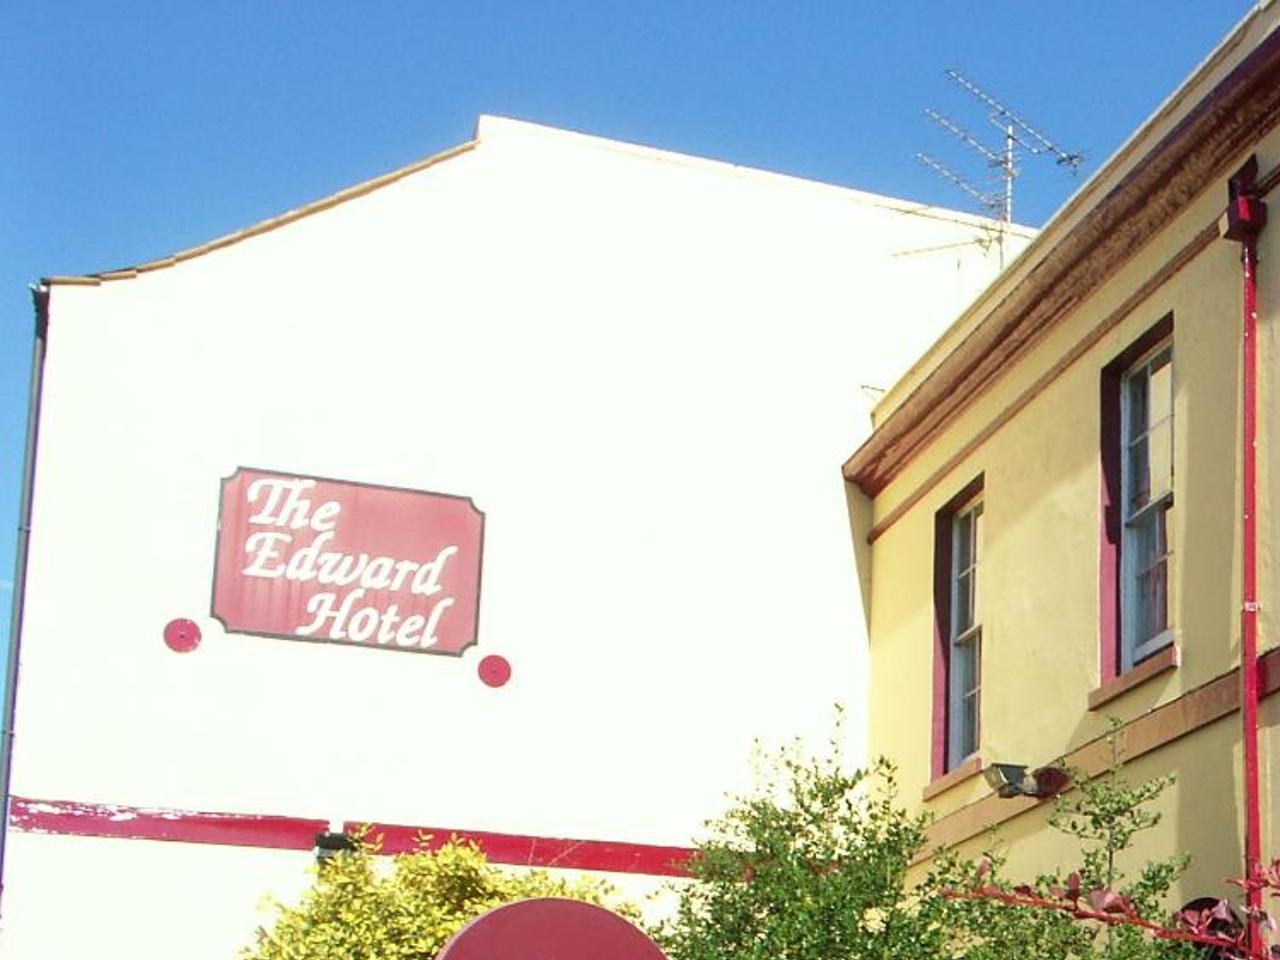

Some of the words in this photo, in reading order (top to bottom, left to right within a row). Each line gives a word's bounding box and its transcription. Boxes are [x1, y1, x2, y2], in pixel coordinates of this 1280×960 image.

[247, 478, 341, 531] The
[242, 531, 458, 596] Edward
[295, 588, 455, 648] Hotel
